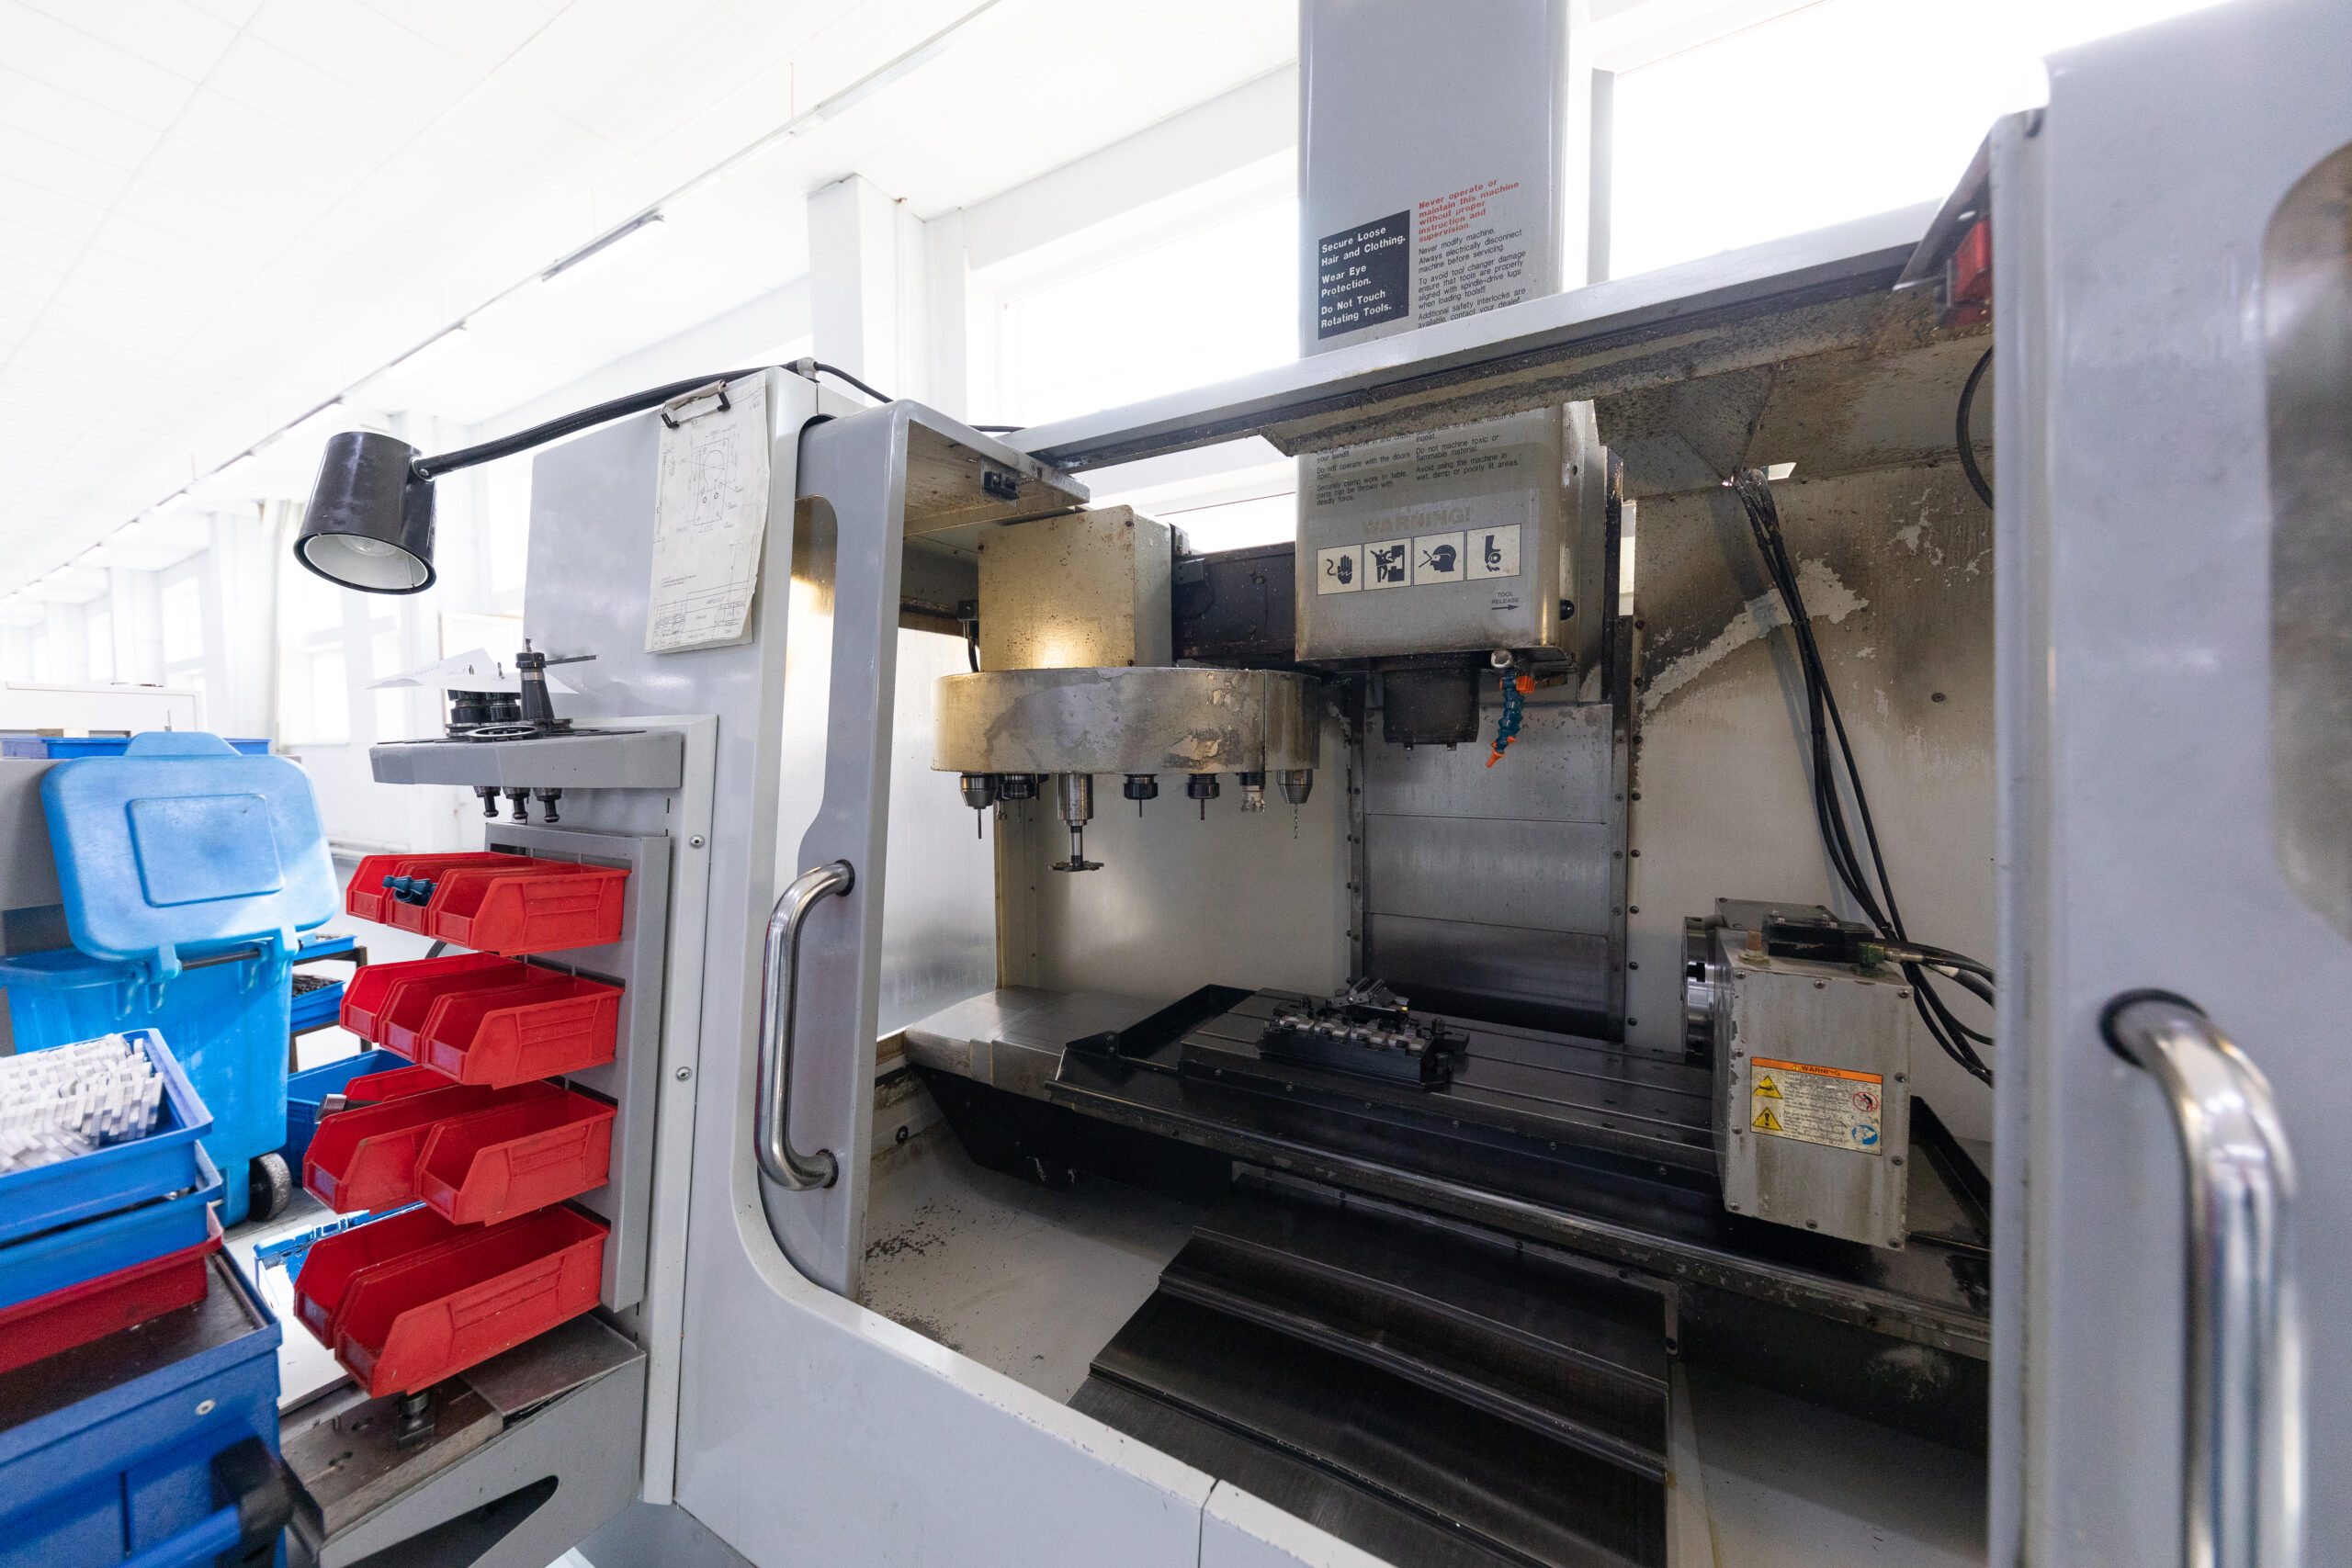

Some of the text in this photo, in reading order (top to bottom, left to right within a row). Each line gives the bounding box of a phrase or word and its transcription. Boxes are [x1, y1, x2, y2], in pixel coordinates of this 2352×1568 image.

[1419, 197, 1443, 209] Never
[1449, 184, 1483, 200] operate
[1419, 182, 1520, 218] maintain this machine
[1419, 200, 1485, 225] without proper
[1419, 209, 1486, 234] instruction and
[1322, 228, 1385, 253] Secure Loose
[1419, 222, 1470, 243] supervision.
[1322, 235, 1406, 266] Hair and Clothing.
[1419, 245, 1437, 255] Never
[1442, 237, 1463, 248] modify
[1419, 230, 1521, 265] Always electrically disconnect
[1322, 265, 1366, 284] Wear Eye
[1419, 261, 1444, 273] machine
[1448, 254, 1469, 265] before
[1430, 272, 1448, 281] avoid
[1453, 266, 1464, 276] tool
[1468, 259, 1495, 271] changer
[1498, 251, 1526, 263] damage
[1419, 282, 1440, 293] ensure
[1443, 277, 1456, 286] that
[1460, 272, 1476, 282] tools
[1495, 258, 1522, 273] properly
[1419, 269, 1521, 301] aligned with spindle-drive lugs
[1321, 278, 1371, 298] Protection.
[1321, 289, 1385, 315] Do Not Touch
[1419, 299, 1435, 310] when
[1439, 293, 1461, 304] loading
[1419, 308, 1449, 320] Additional
[1453, 301, 1473, 311] safety
[1477, 292, 1510, 304] interlocks
[1451, 309, 1476, 320] contact
[1480, 304, 1494, 313] your
[1321, 303, 1391, 328] Rotating Tools.
[1442, 440, 1467, 449] machine
[1340, 461, 1362, 470] operate
[1416, 464, 1433, 473] Avoid
[1437, 462, 1453, 470] using
[1471, 454, 1498, 464] machine
[1433, 470, 1450, 479] damp
[1464, 465, 1484, 474] poorly
[1317, 482, 1340, 491] Securely
[1317, 491, 1331, 499] parts
[1358, 483, 1377, 491] thrown
[1317, 497, 1335, 506] deadly
[1362, 507, 1471, 535] WARNING!
